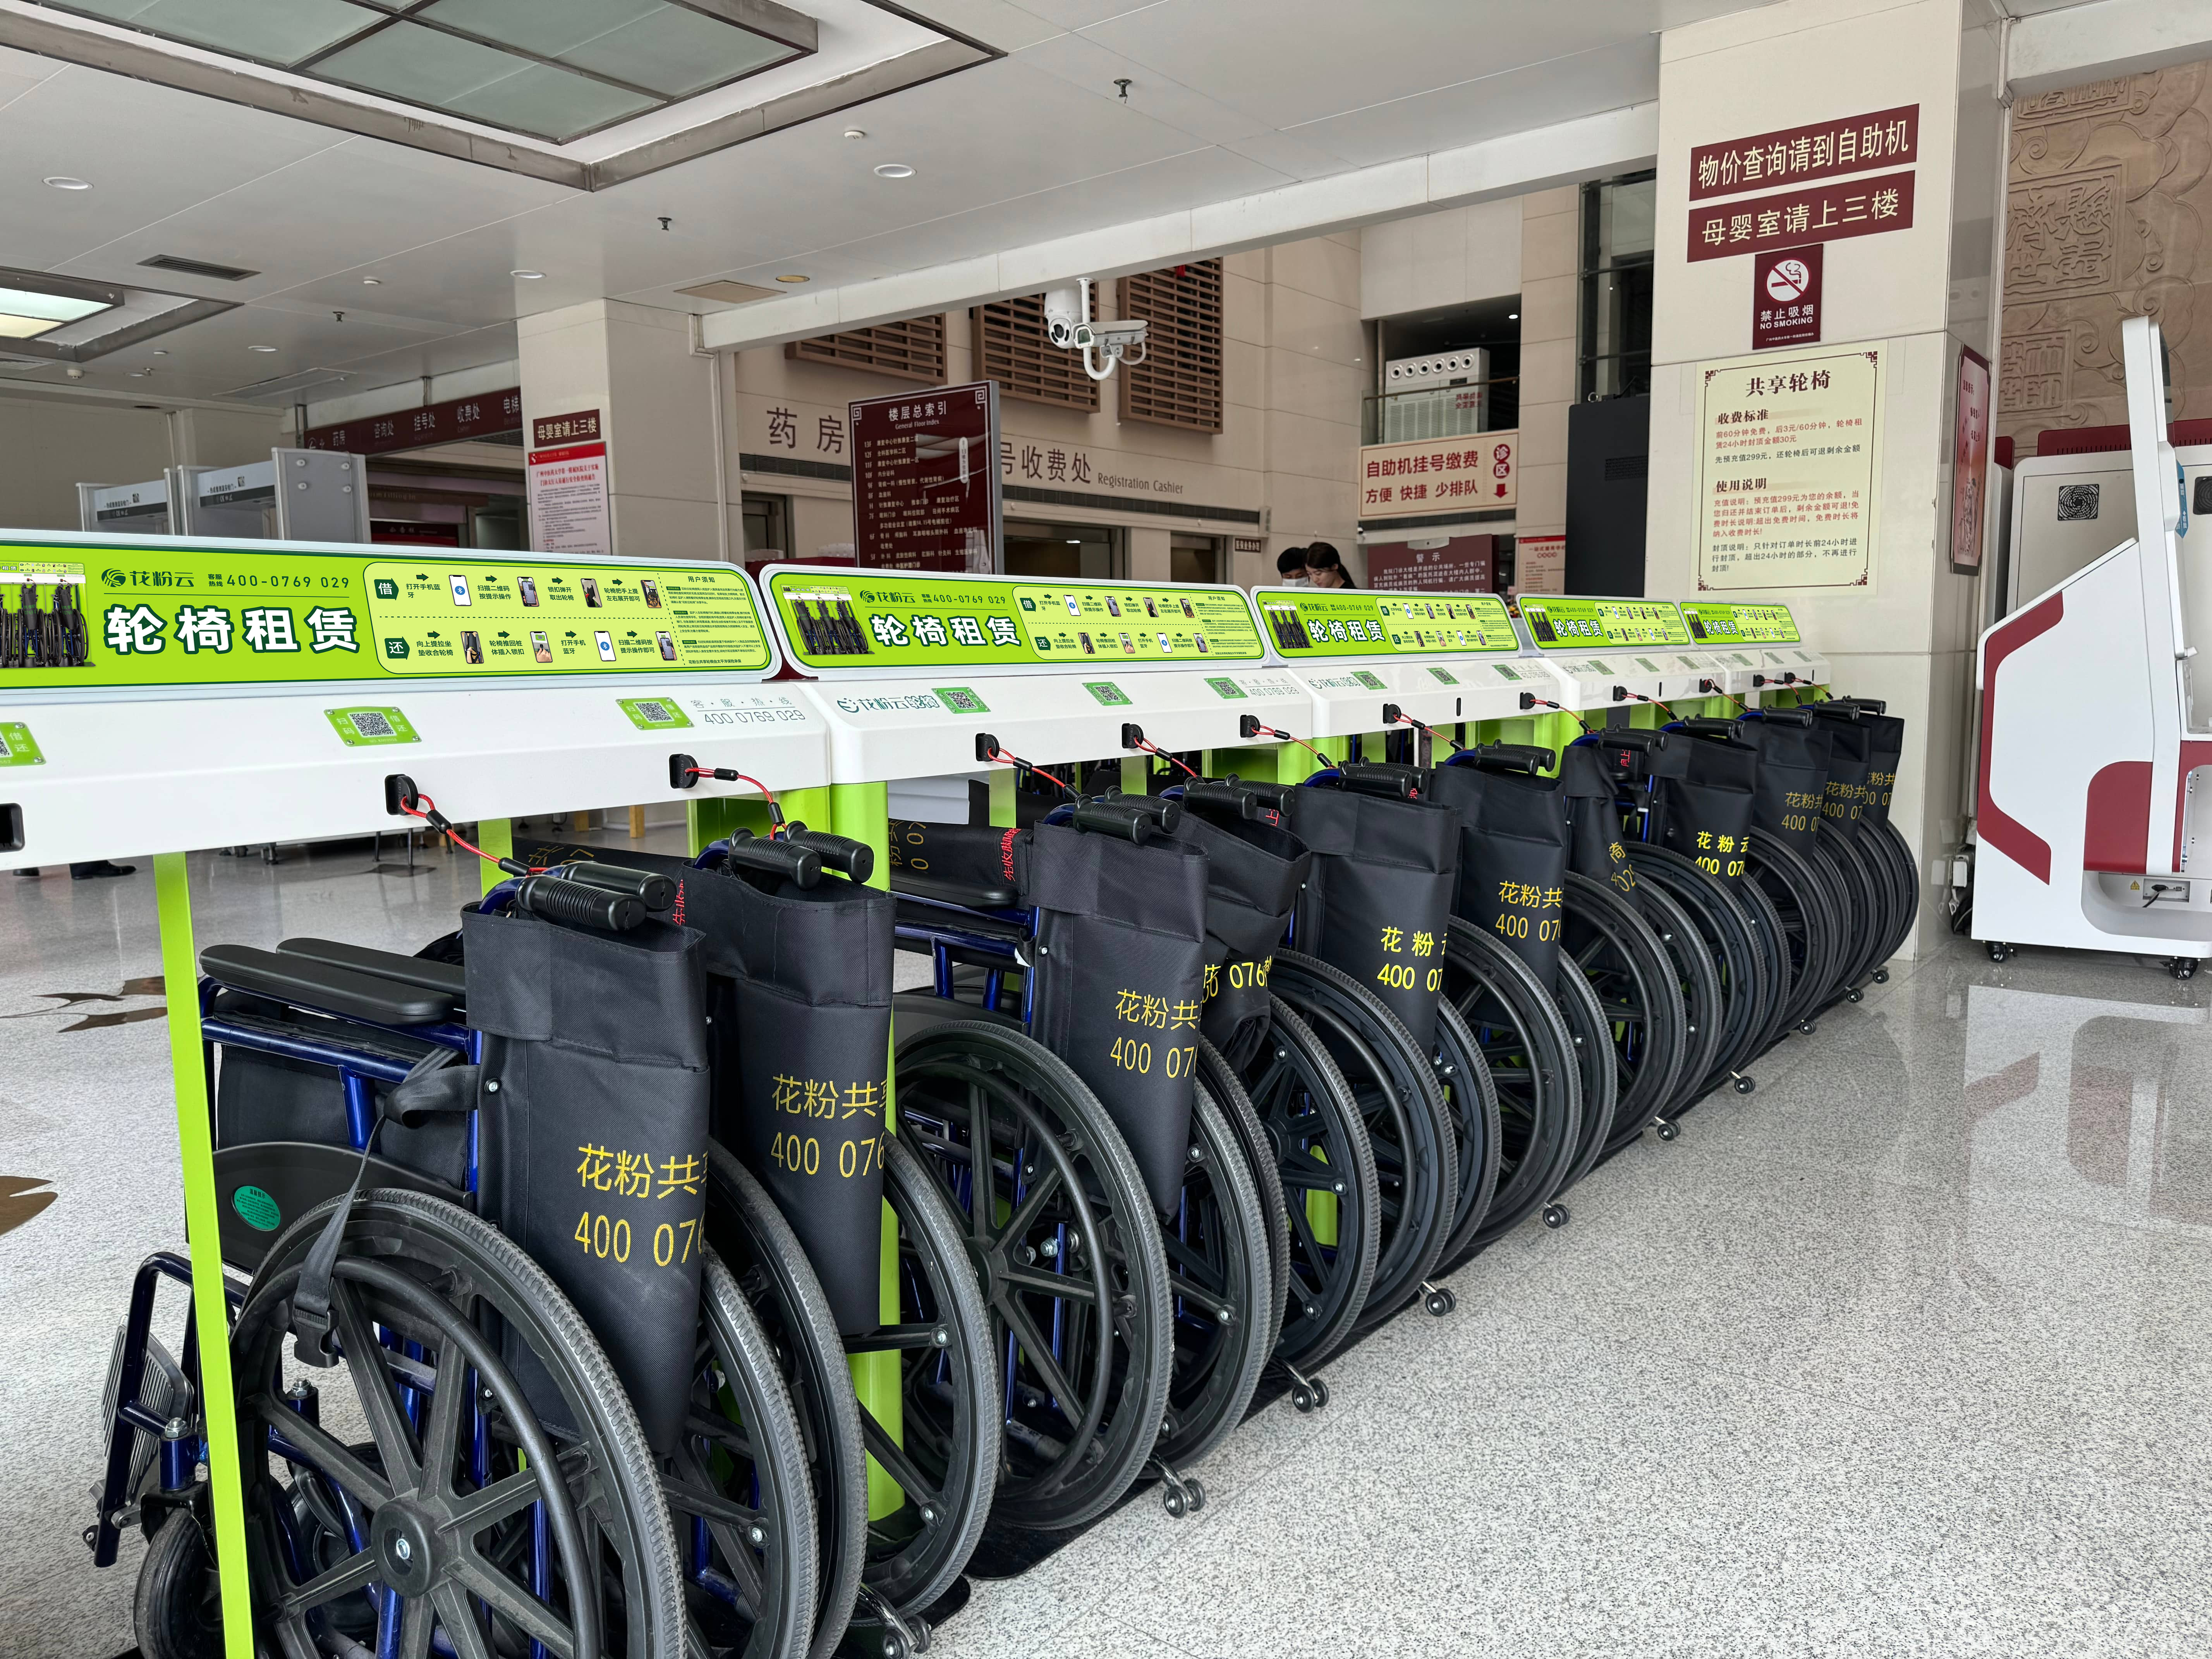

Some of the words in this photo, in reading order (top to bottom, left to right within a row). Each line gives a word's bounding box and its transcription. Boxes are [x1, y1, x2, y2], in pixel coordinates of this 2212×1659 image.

[1698, 120, 1908, 189] 物价查询请到自助机
[1702, 189, 1899, 246] 母婴室请上三楼
[1760, 304, 1814, 322] 禁止吸烟
[1774, 316, 1813, 328] SMOKING
[1745, 369, 1831, 398] 共享轮椅
[457, 403, 480, 423] 收费处
[889, 400, 947, 422] 楼层总索引
[1717, 409, 1769, 425] 收费标准
[374, 419, 394, 438] 咨询处
[414, 412, 435, 431] 挂号处
[537, 417, 597, 441] 母婴室请上三楼
[767, 407, 845, 454] 药房
[895, 422, 913, 430] General
[332, 430, 345, 446] 药房
[1716, 435, 1797, 449] 赁24小时封顶金额30元
[1367, 450, 1478, 479] 自助机挂号缴费
[1494, 446, 1510, 478] 诊区
[1098, 472, 1149, 490] Registration
[1153, 480, 1183, 495] Cashier
[1366, 487, 1392, 503] 方便
[1400, 484, 1427, 501] 快捷
[1435, 479, 1478, 498] 少排队
[1716, 477, 1767, 493] 使用说明
[1416, 552, 1441, 563] 警示
[129, 571, 194, 587] 花粉云
[227, 575, 311, 587] 400-0769
[321, 577, 349, 588] 029
[378, 582, 393, 595] 借
[875, 592, 915, 603] 花粉云
[934, 595, 983, 603] 400-0769
[988, 596, 1005, 604] 029
[1023, 600, 1033, 609] 借
[105, 605, 359, 654] 轮椅租赁
[871, 615, 1020, 646] 轮椅租赁
[1308, 620, 1386, 642] 轮椅租赁
[1553, 619, 1603, 636] 轮椅租赁
[1704, 620, 1738, 635] 轮椅租赁
[389, 641, 404, 654] 还
[1038, 639, 1048, 647] 还
[858, 696, 940, 711] 花粉云轮椅
[705, 713, 733, 725] 400
[735, 712, 775, 723] 0769
[776, 710, 805, 721] 029
[1825, 781, 1866, 799] 花粉共
[1822, 802, 1844, 818] 400
[1782, 814, 1806, 831] 400
[1495, 914, 1528, 939] 400
[1377, 963, 1415, 989] 400
[1116, 989, 1201, 1030] 花粉共
[1110, 1036, 1152, 1073] 400
[1166, 1047, 1196, 1079] 07
[772, 1073, 886, 1120] 花粉共
[771, 1131, 819, 1175] 400
[577, 1142, 708, 1199] 花粉共
[575, 1212, 632, 1263] 400
